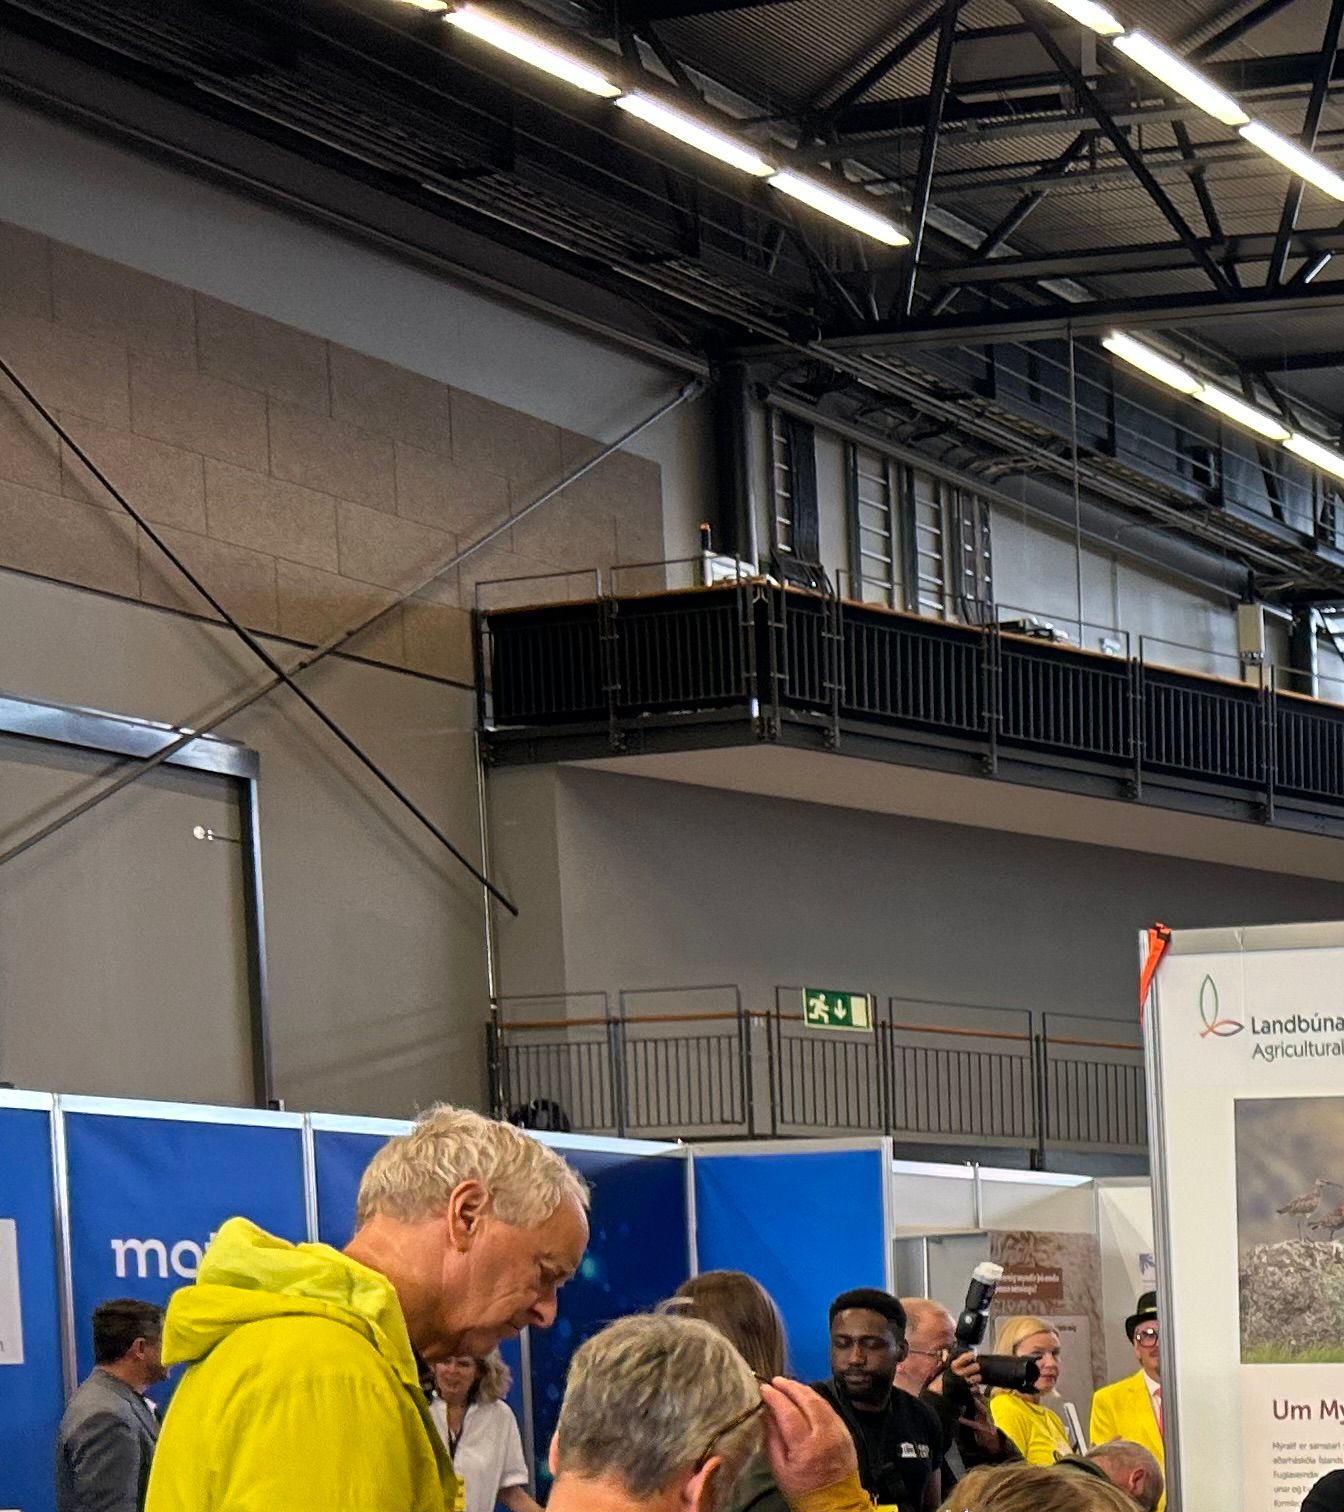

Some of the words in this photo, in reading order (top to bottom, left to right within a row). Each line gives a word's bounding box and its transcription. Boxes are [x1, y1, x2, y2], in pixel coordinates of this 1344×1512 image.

[1252, 1038, 1344, 1062] Agricultural
[111, 1232, 216, 1279] ma
[1273, 1400, 1311, 1420] Um
